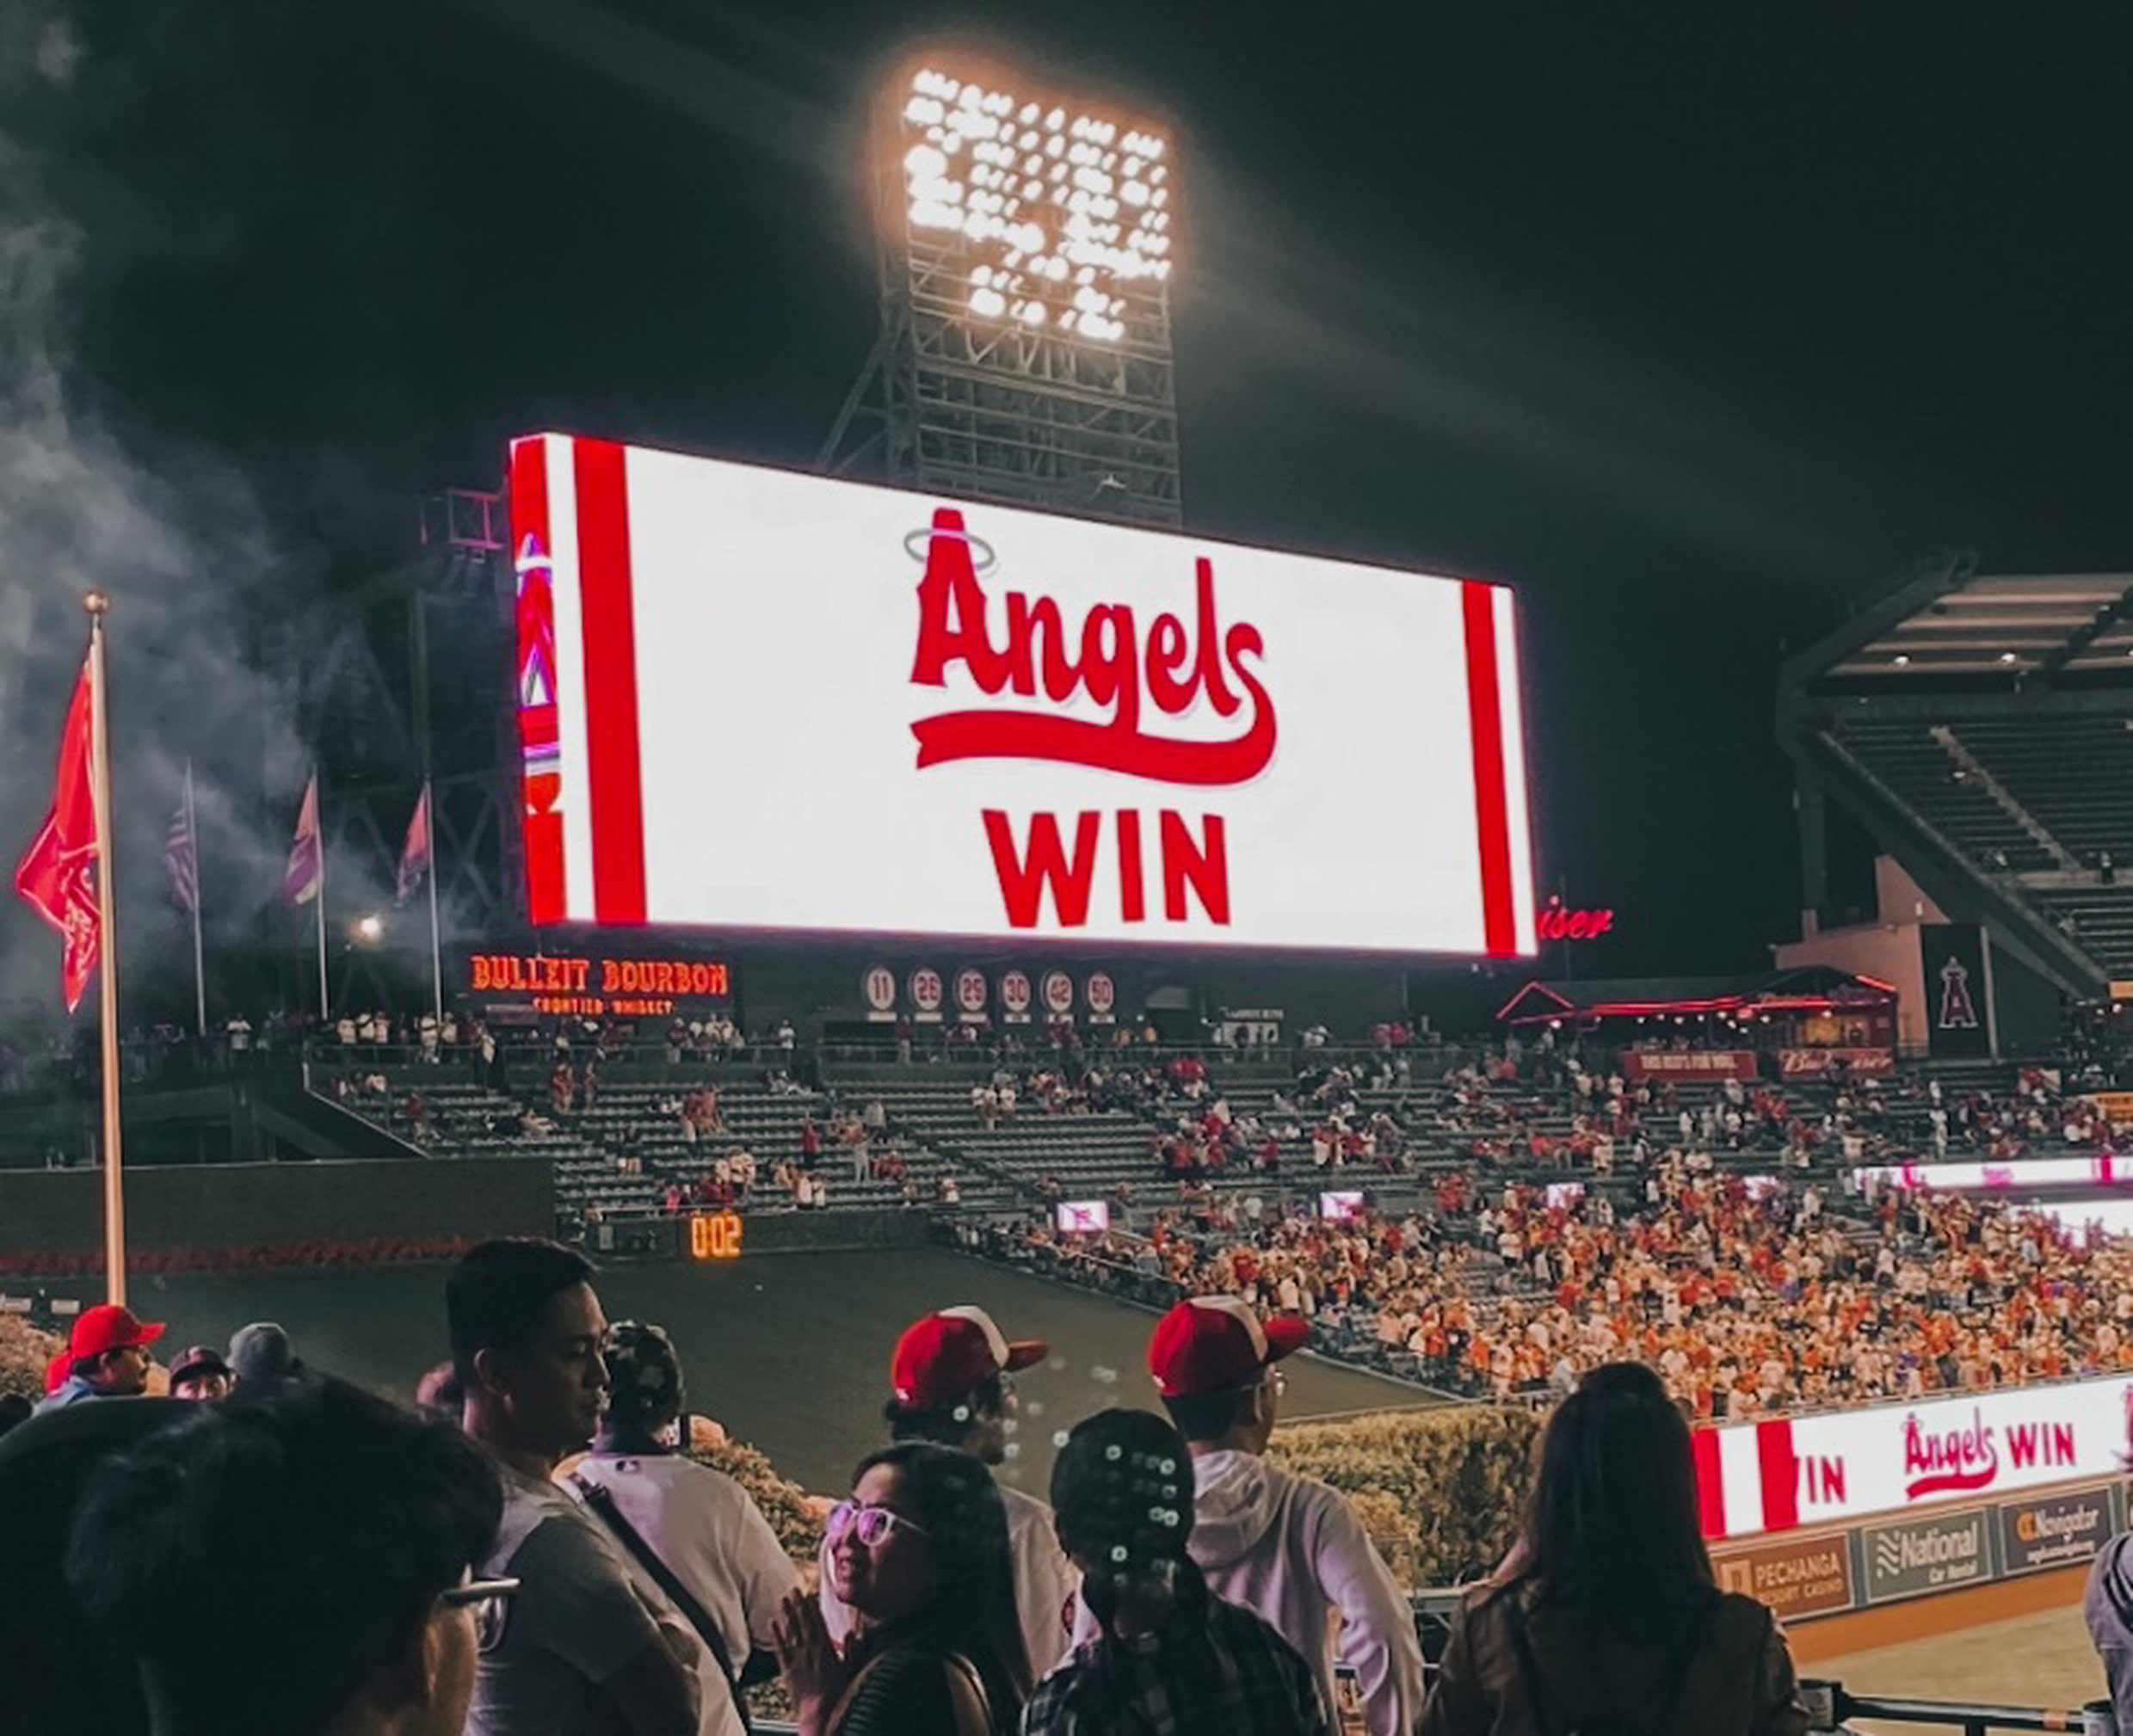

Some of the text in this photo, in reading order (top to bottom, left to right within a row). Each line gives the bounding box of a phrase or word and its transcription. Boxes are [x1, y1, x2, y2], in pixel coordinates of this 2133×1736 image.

[904, 507, 1278, 785] Angels
[981, 808, 1230, 927] WIN
[601, 960, 728, 994] BOURBON
[917, 976, 939, 1001] 26
[1902, 1407, 1998, 1499] Angels
[2007, 1422, 2076, 1469] WIN
[1795, 1456, 1846, 1504] IN
[1901, 1520, 1978, 1569] National
[1755, 1552, 1841, 1589] PECHANGA
